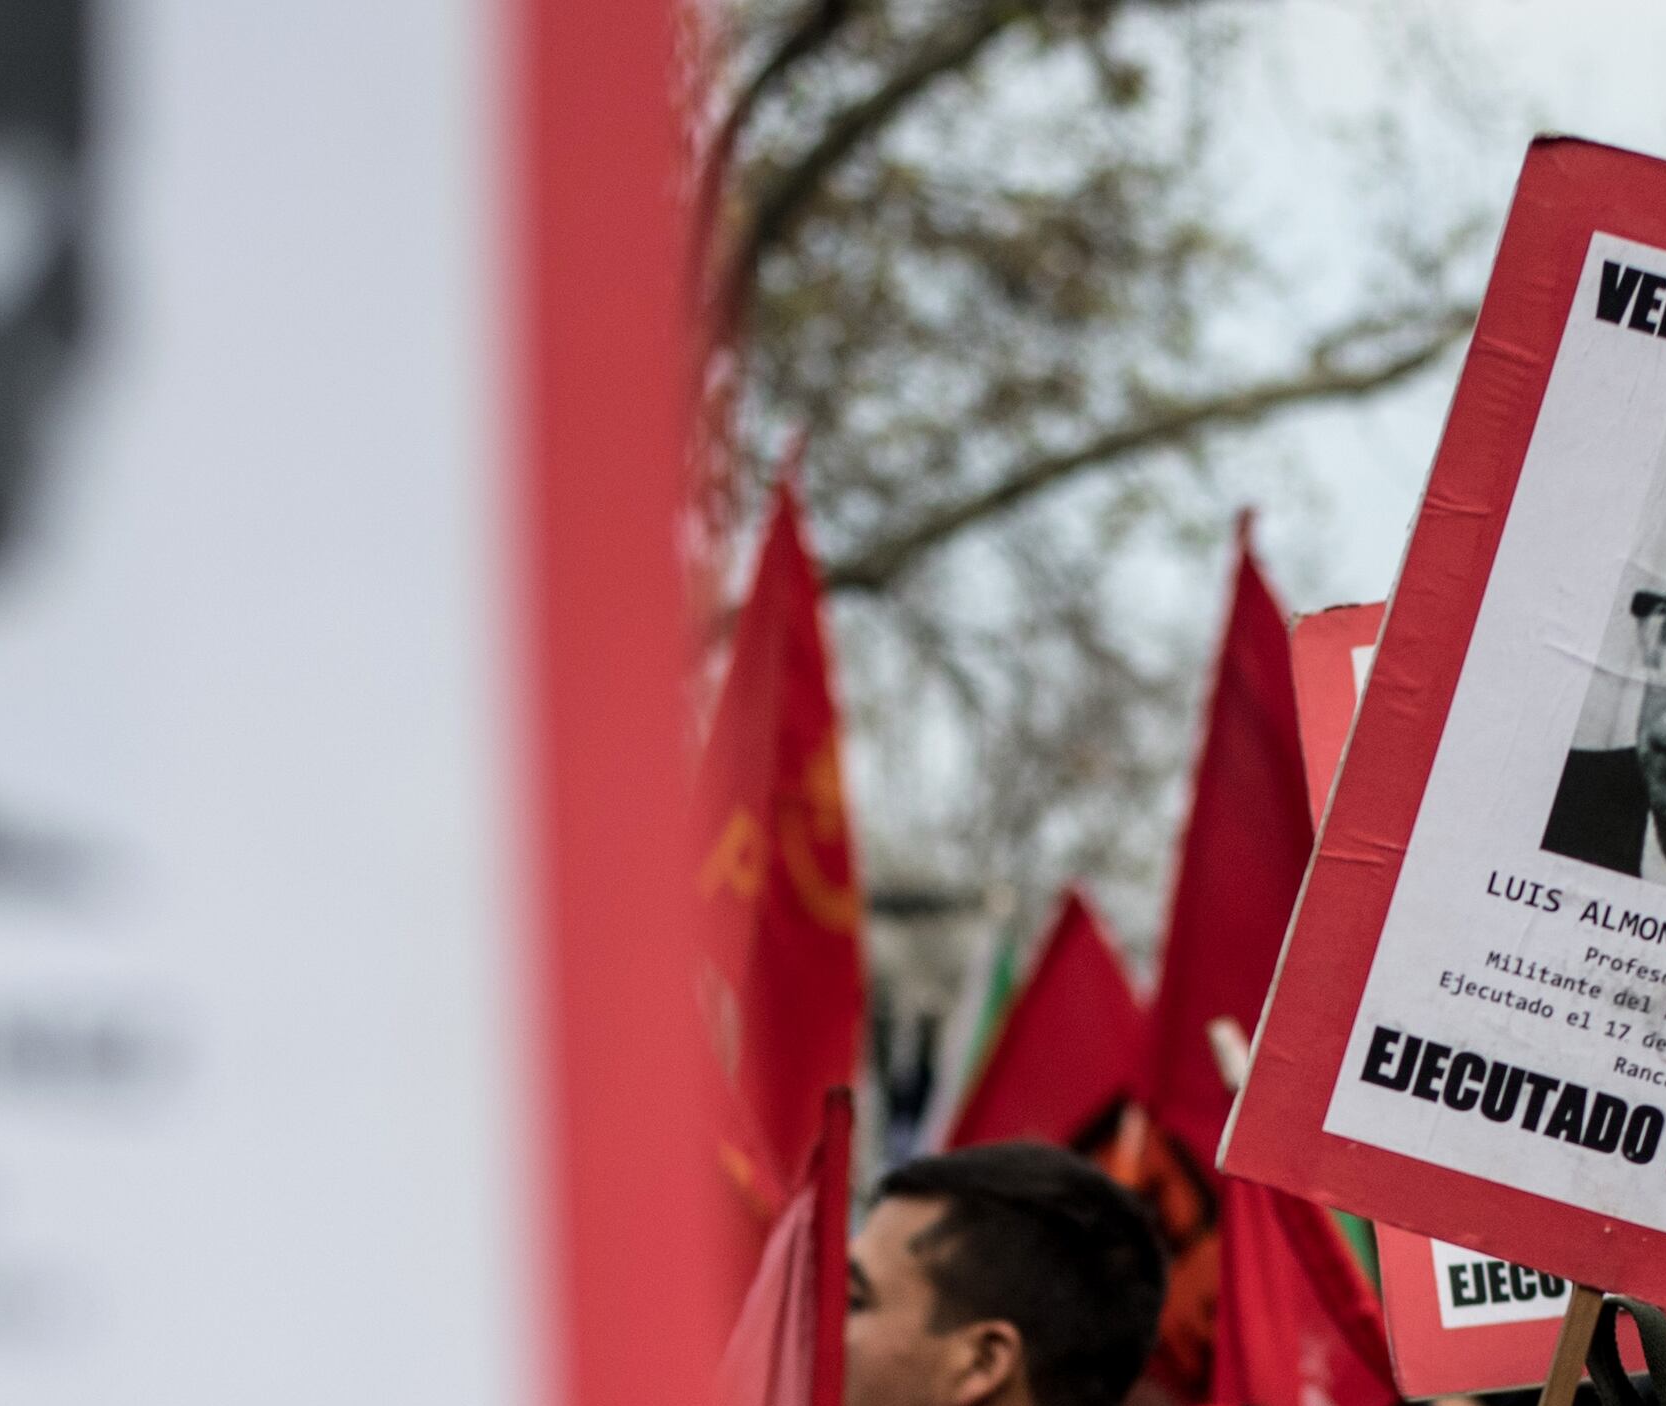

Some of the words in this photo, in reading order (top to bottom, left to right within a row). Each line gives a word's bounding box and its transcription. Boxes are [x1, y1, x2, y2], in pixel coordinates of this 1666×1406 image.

[1487, 871, 1563, 913] LUIS
[1439, 970, 1554, 1019] Ejecutado
[1566, 1011, 1590, 1030] el
[1604, 1020, 1632, 1040] 17
[1485, 951, 1602, 999] Militante
[1612, 989, 1651, 1014] del
[1360, 1025, 1665, 1165] EJECUTADO
